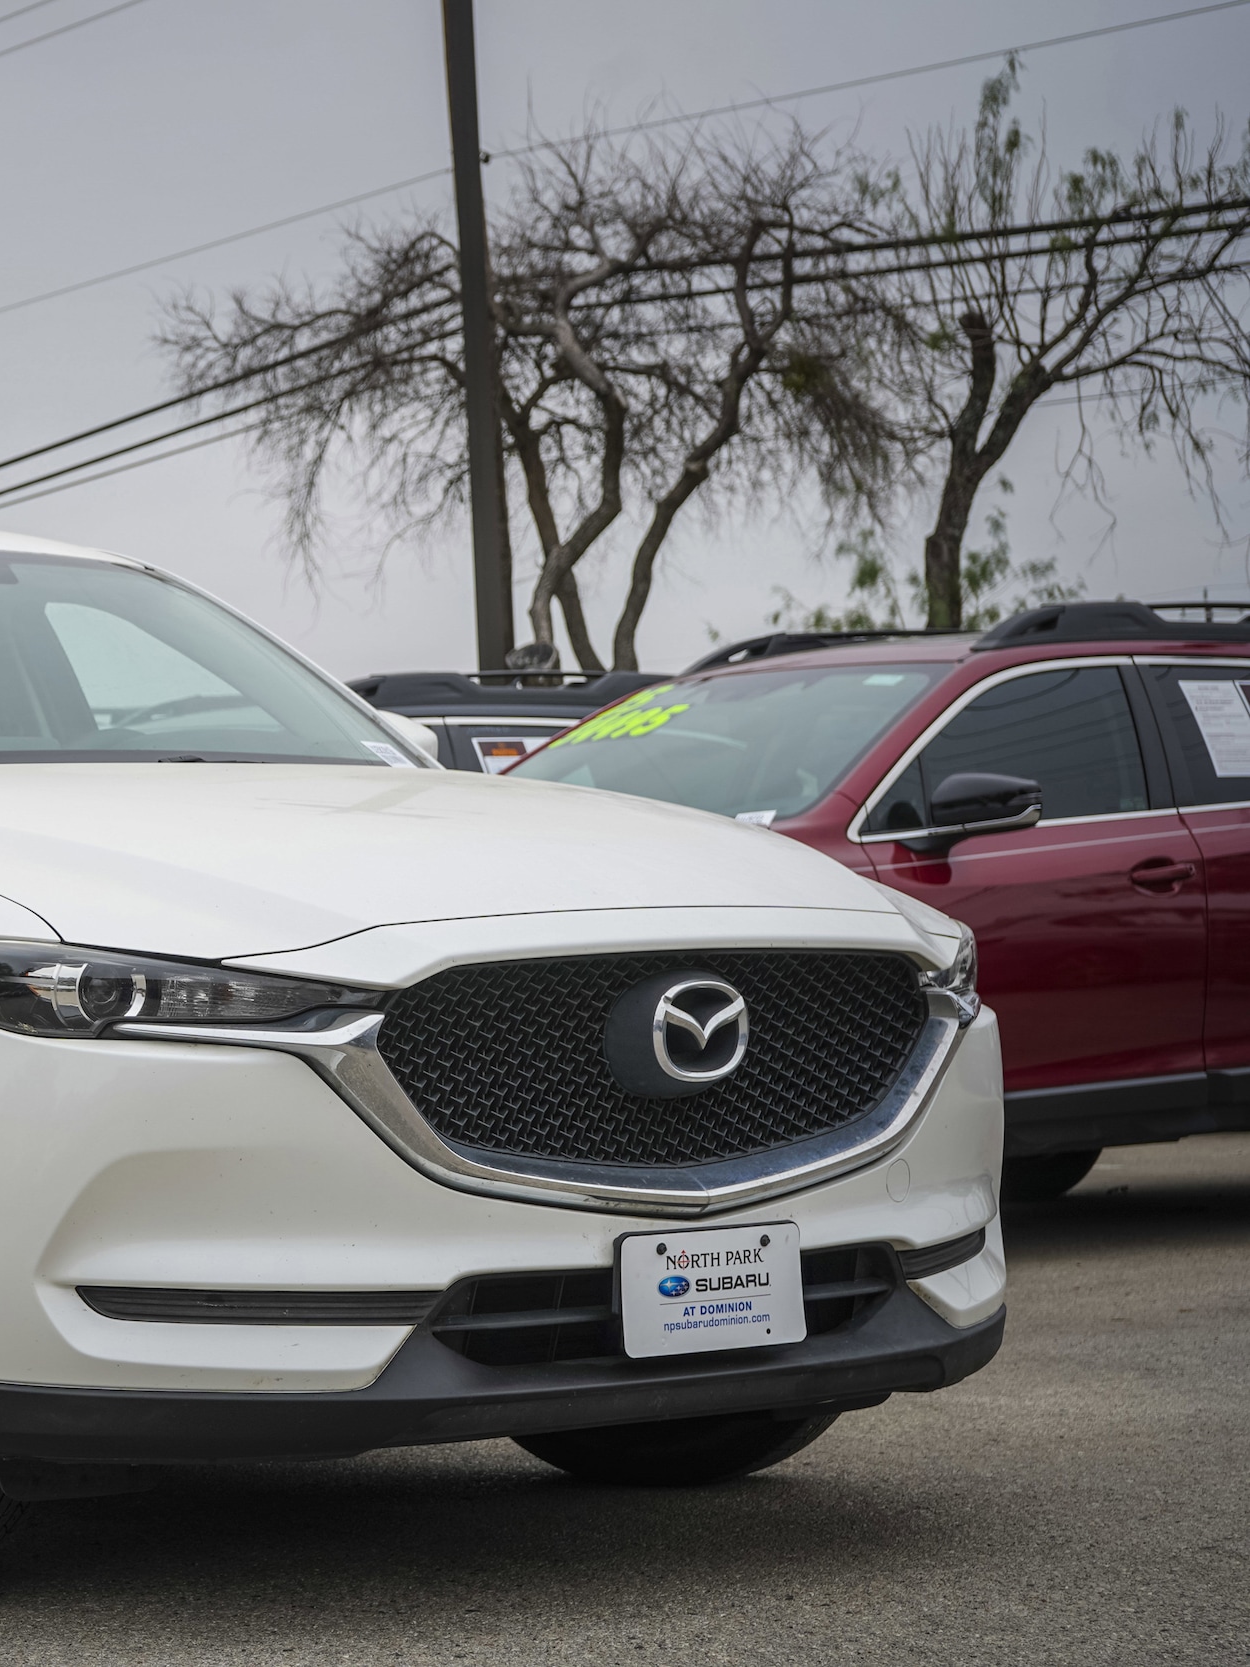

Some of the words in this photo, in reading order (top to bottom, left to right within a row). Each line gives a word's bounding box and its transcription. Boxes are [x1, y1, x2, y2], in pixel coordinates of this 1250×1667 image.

[665, 1250, 721, 1271] NORTH
[725, 1247, 765, 1267] PARK
[695, 1272, 770, 1293] SUBARU
[682, 1306, 696, 1317] AT
[700, 1301, 753, 1316] DOMINION
[663, 1312, 771, 1333] npsubarudominion.com
